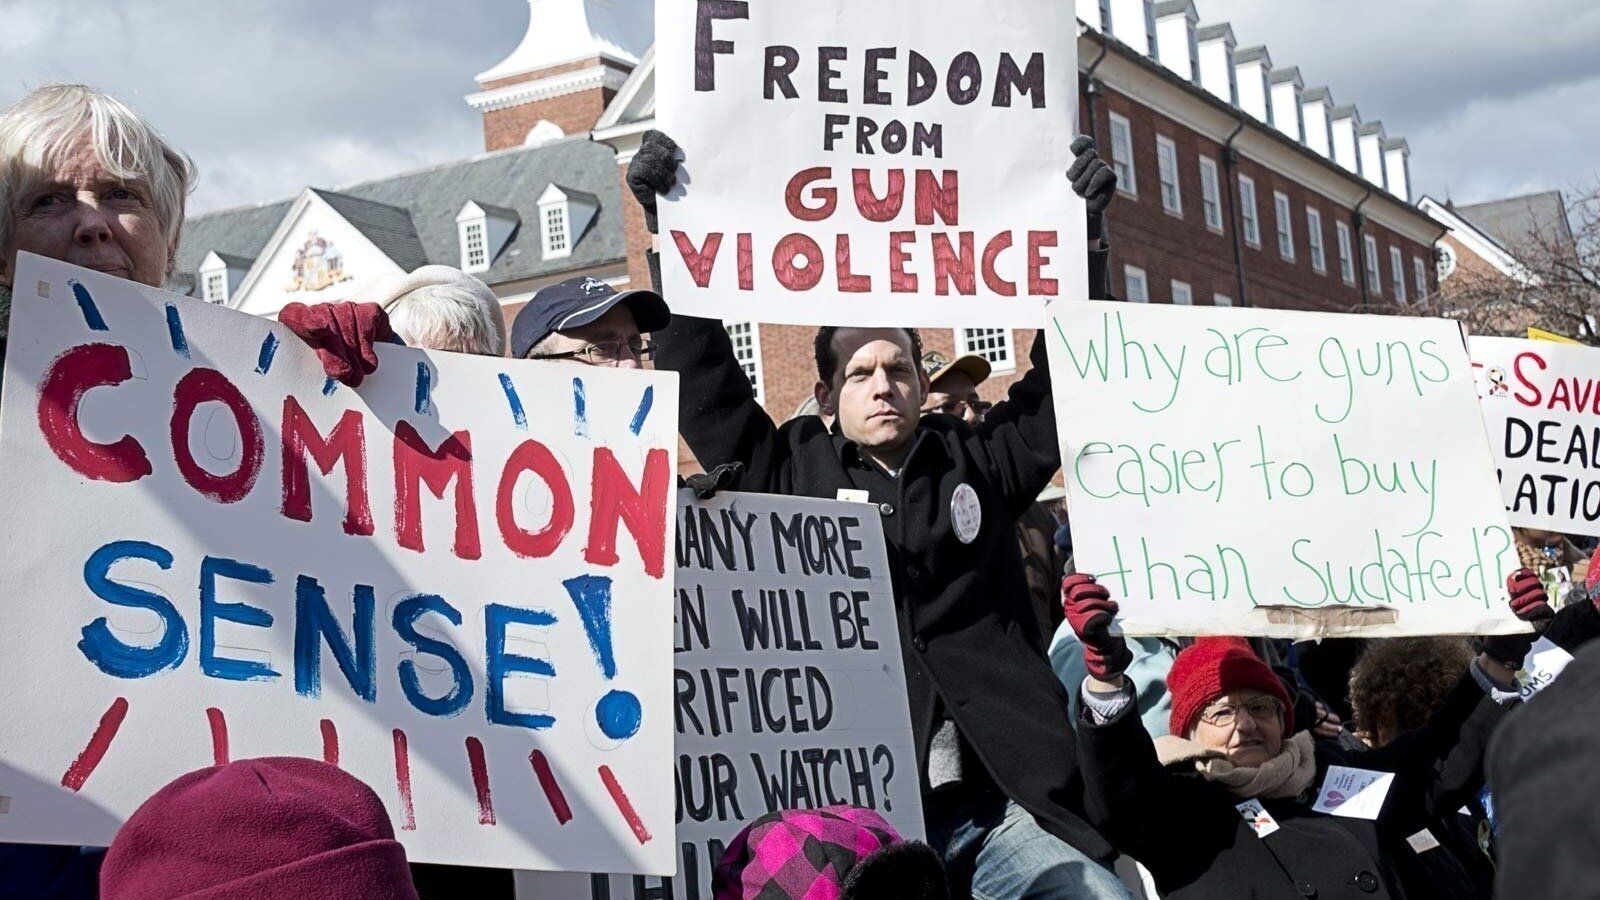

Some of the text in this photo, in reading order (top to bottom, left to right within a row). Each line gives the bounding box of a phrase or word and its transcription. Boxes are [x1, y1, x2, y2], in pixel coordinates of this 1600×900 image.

[694, 0, 1046, 108] FREEDOM
[823, 114, 943, 158] FROM
[784, 166, 959, 226] GUN
[670, 229, 1059, 297] VIOLENCE
[1053, 311, 1185, 412] Why
[1205, 327, 1302, 385] are
[1315, 337, 1450, 423] guns
[37, 342, 671, 579] COMMON
[1075, 421, 1436, 537] easier to buy
[1497, 468, 1600, 521] ATIO
[770, 512, 871, 579] MORE
[1096, 526, 1511, 609] than Sudafed?
[77, 540, 641, 740] SENSE!
[731, 588, 823, 652] WILL
[829, 591, 879, 650] BE
[674, 666, 833, 737] RIFICED
[750, 744, 895, 812] WATCH?
